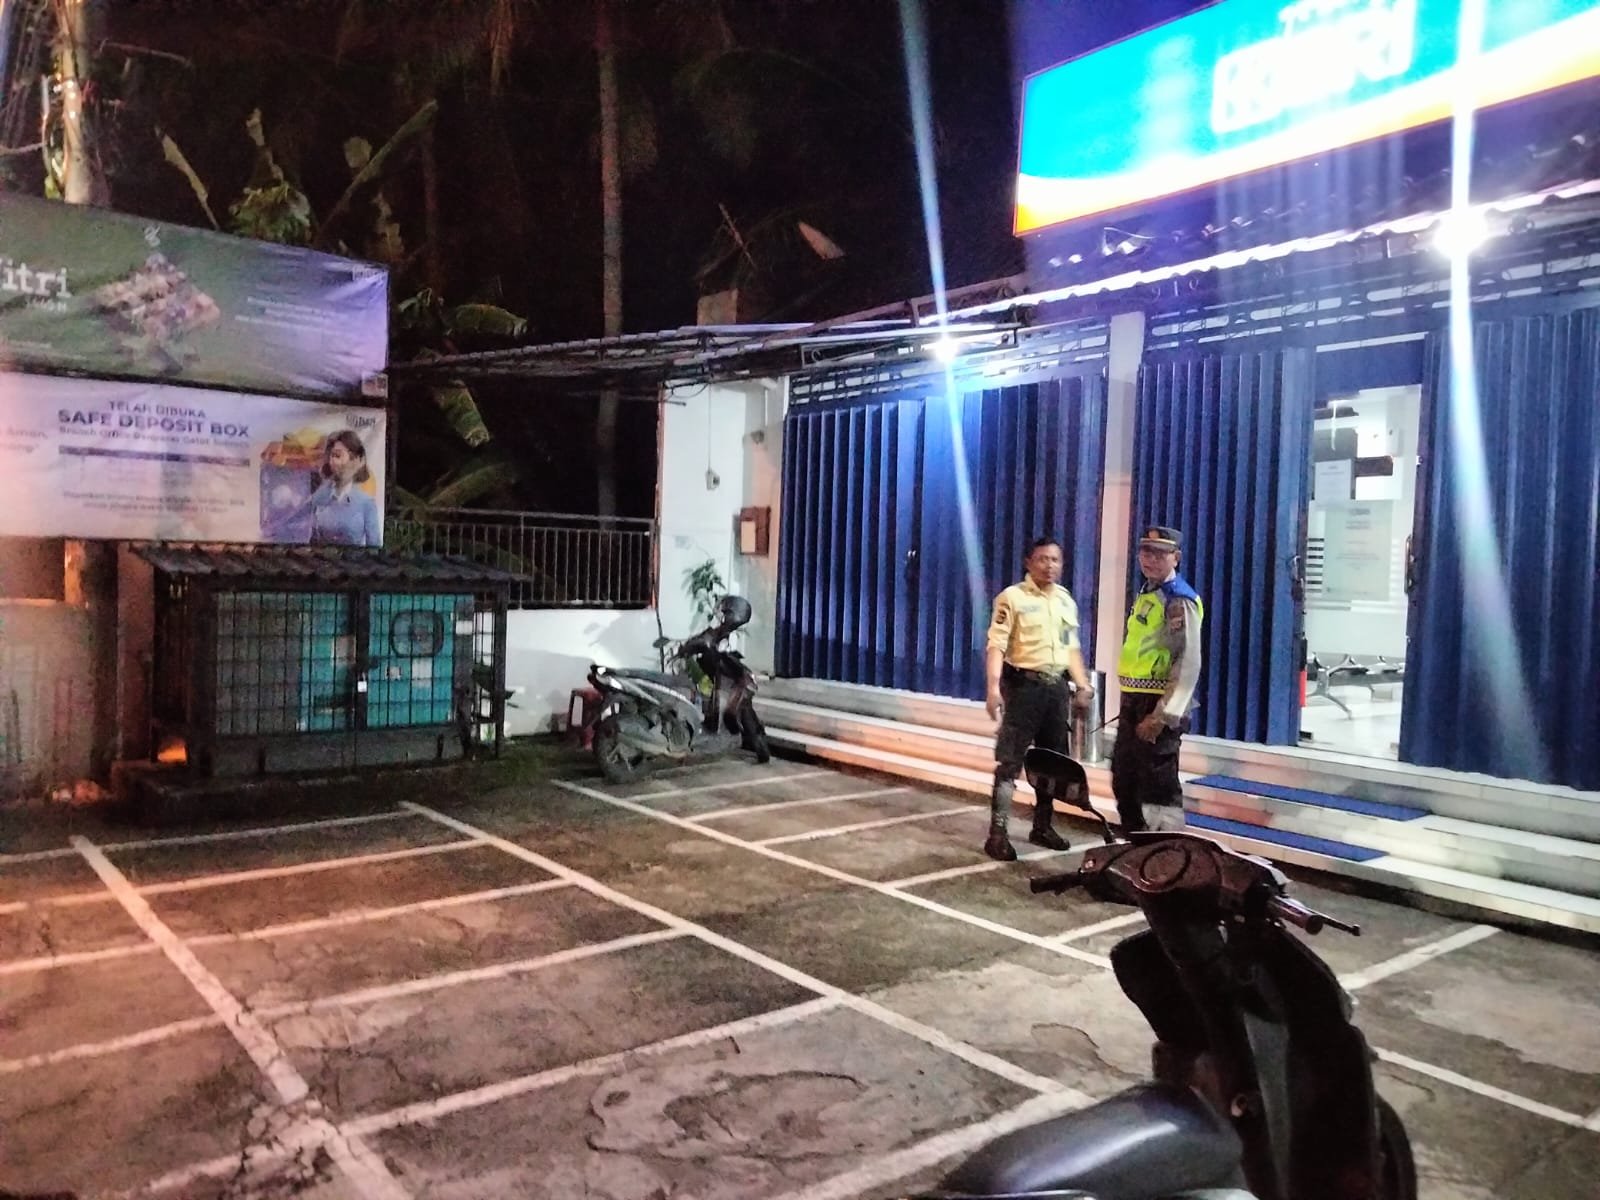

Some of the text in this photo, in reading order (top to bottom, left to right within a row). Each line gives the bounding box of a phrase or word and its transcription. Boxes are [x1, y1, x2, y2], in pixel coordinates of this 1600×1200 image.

[0, 258, 72, 298] itri
[58, 408, 249, 437] SAFE DEPOSIT BOX
[156, 405, 206, 418] DIBUKA
